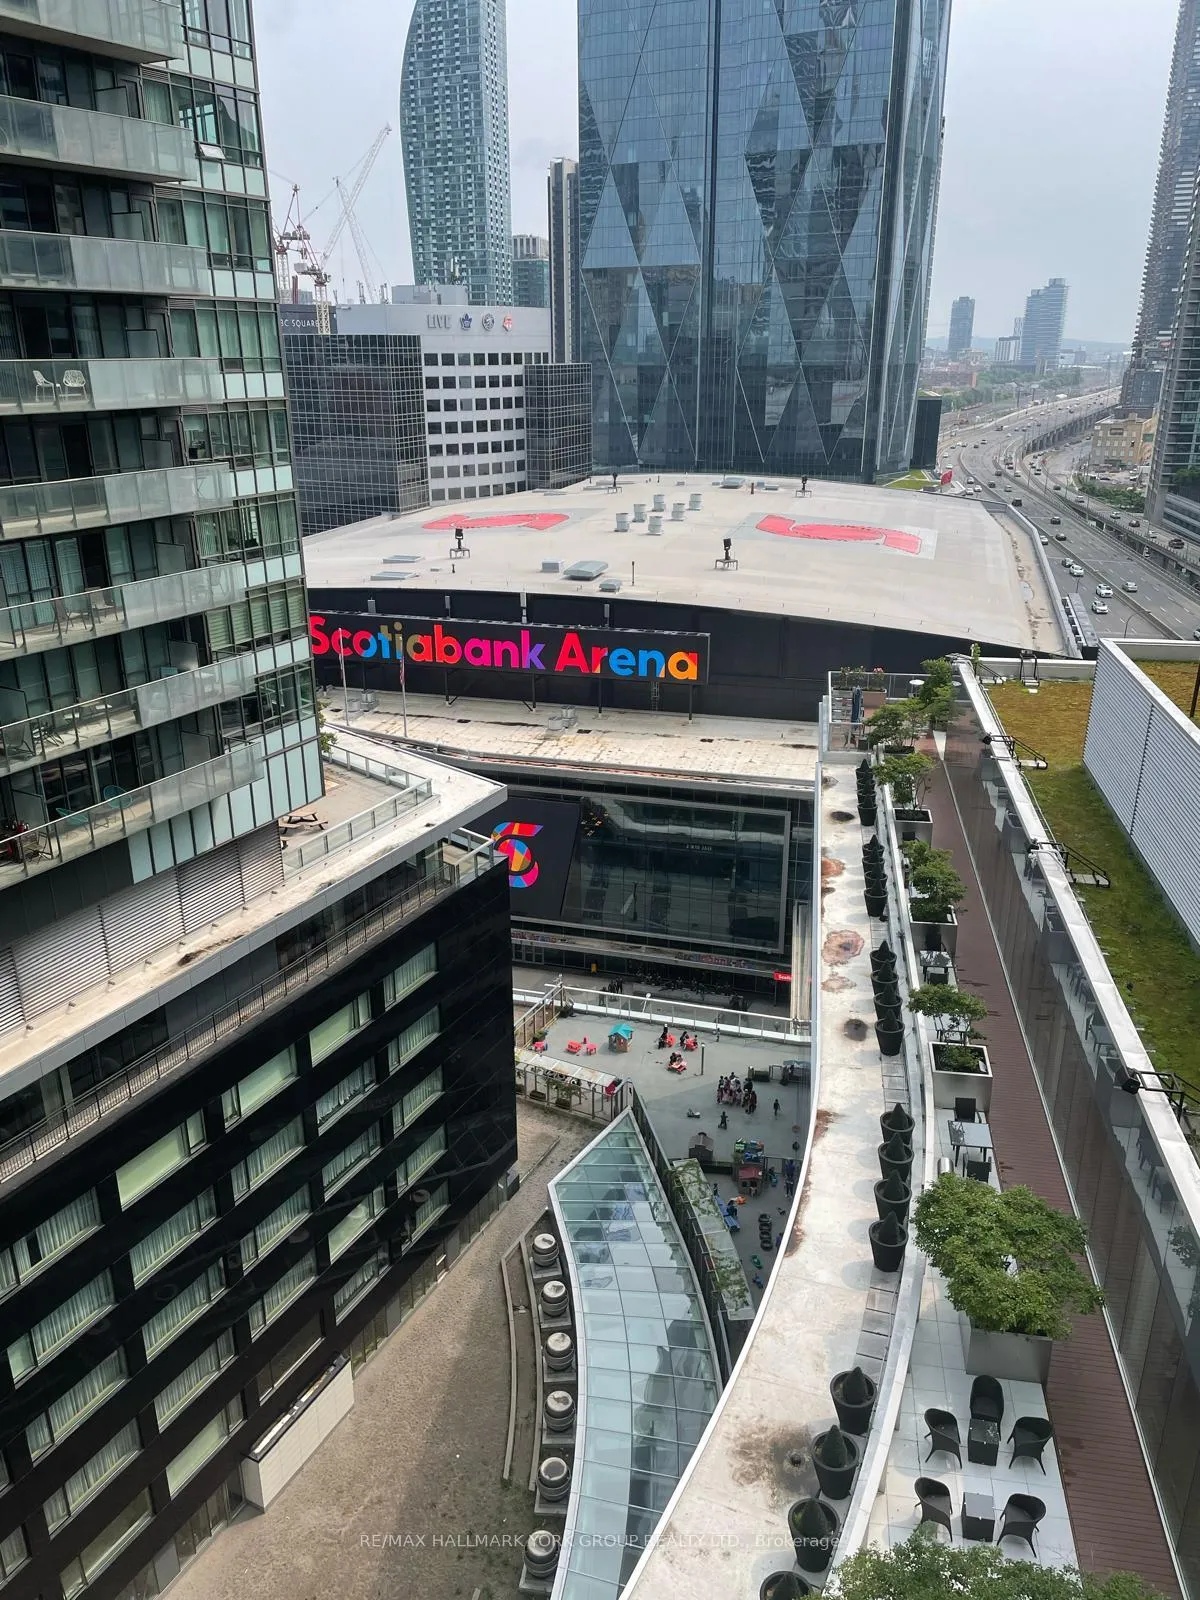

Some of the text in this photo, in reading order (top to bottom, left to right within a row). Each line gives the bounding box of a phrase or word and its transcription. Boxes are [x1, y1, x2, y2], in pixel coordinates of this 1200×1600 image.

[426, 314, 452, 329] LIVE
[309, 614, 699, 680] Scotiabank Arena
